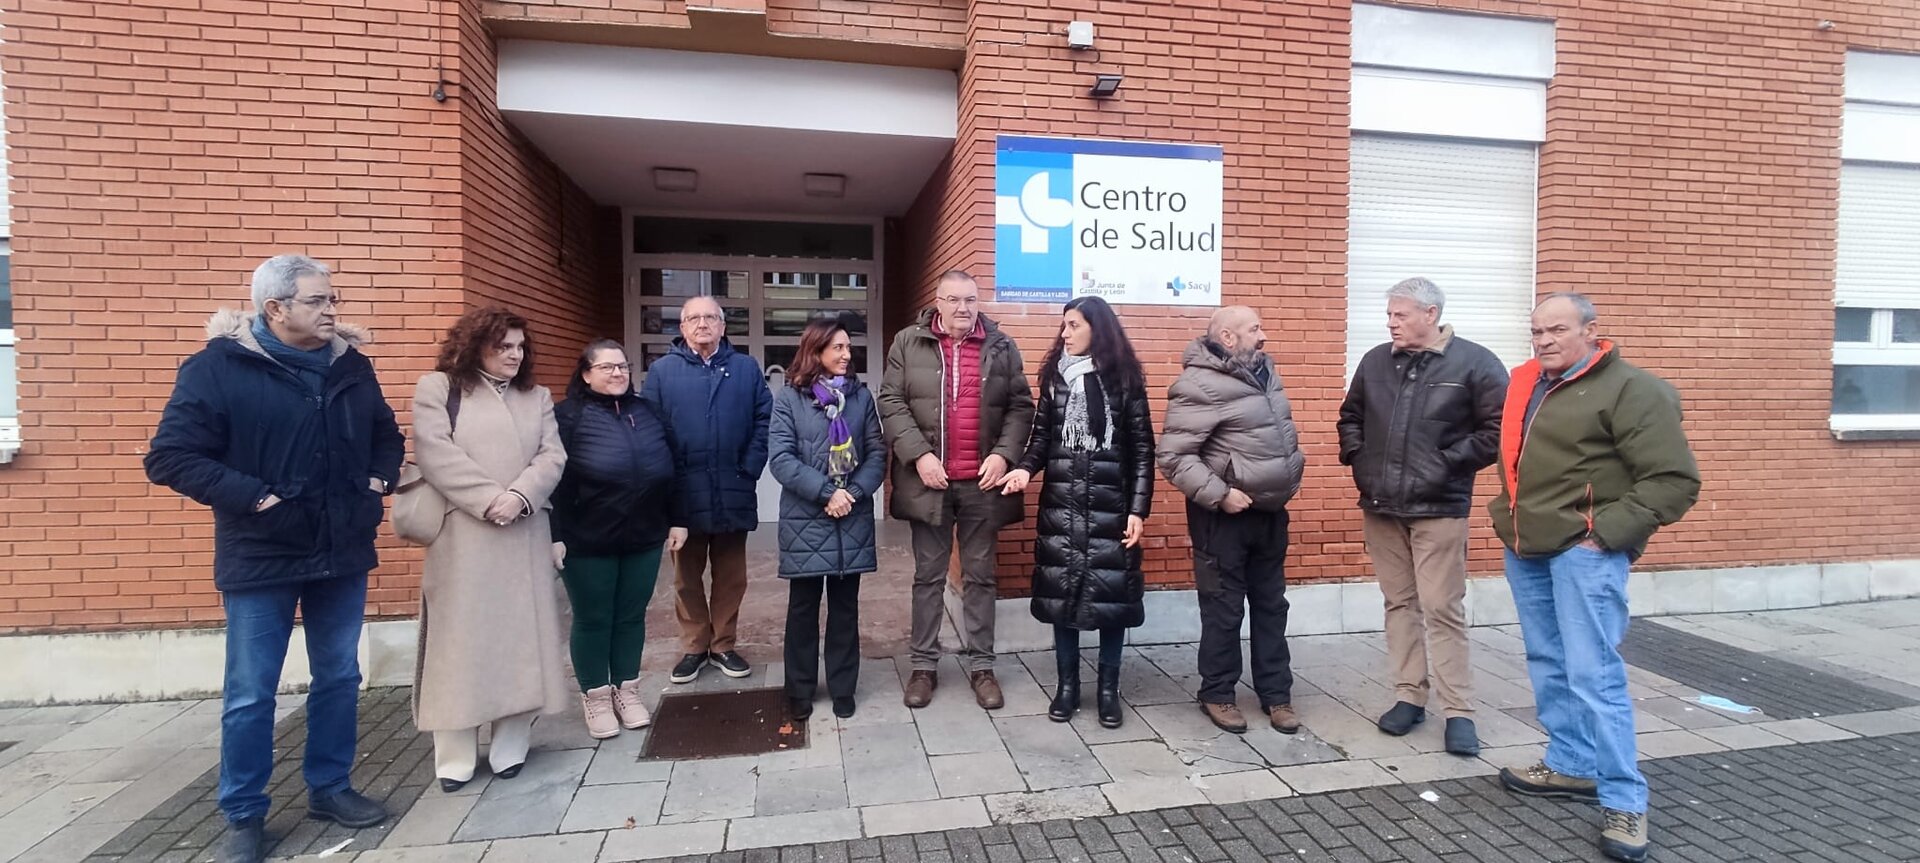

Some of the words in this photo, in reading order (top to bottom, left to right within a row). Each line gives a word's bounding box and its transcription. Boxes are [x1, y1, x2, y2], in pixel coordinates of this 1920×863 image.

[1080, 181, 1187, 213] Centro
[1080, 218, 1119, 250] de
[1131, 221, 1215, 252] Salud
